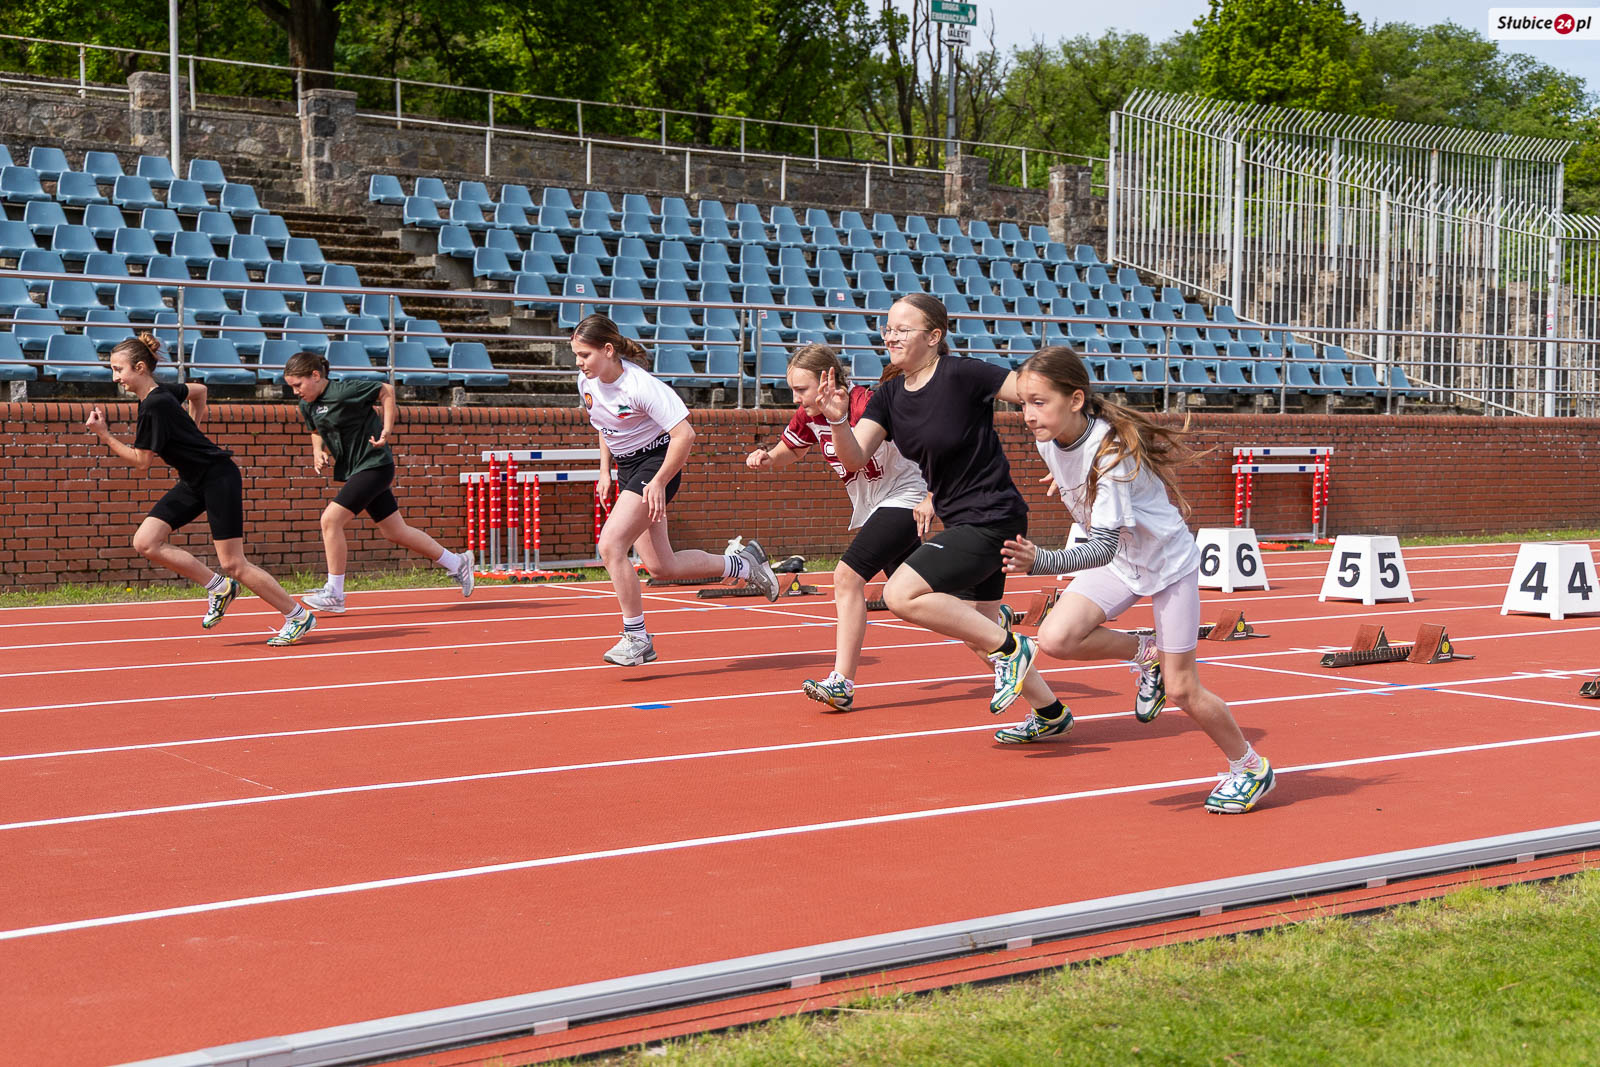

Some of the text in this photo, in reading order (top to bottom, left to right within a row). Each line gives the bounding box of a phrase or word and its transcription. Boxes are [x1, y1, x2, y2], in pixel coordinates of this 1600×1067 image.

[642, 435, 669, 452] NIKE
[1200, 543, 1220, 577] 6
[1236, 543, 1257, 577] 6
[1337, 552, 1361, 587] 5
[1378, 552, 1400, 588] 5
[1520, 562, 1548, 600] 4
[1568, 562, 1592, 600] 4
